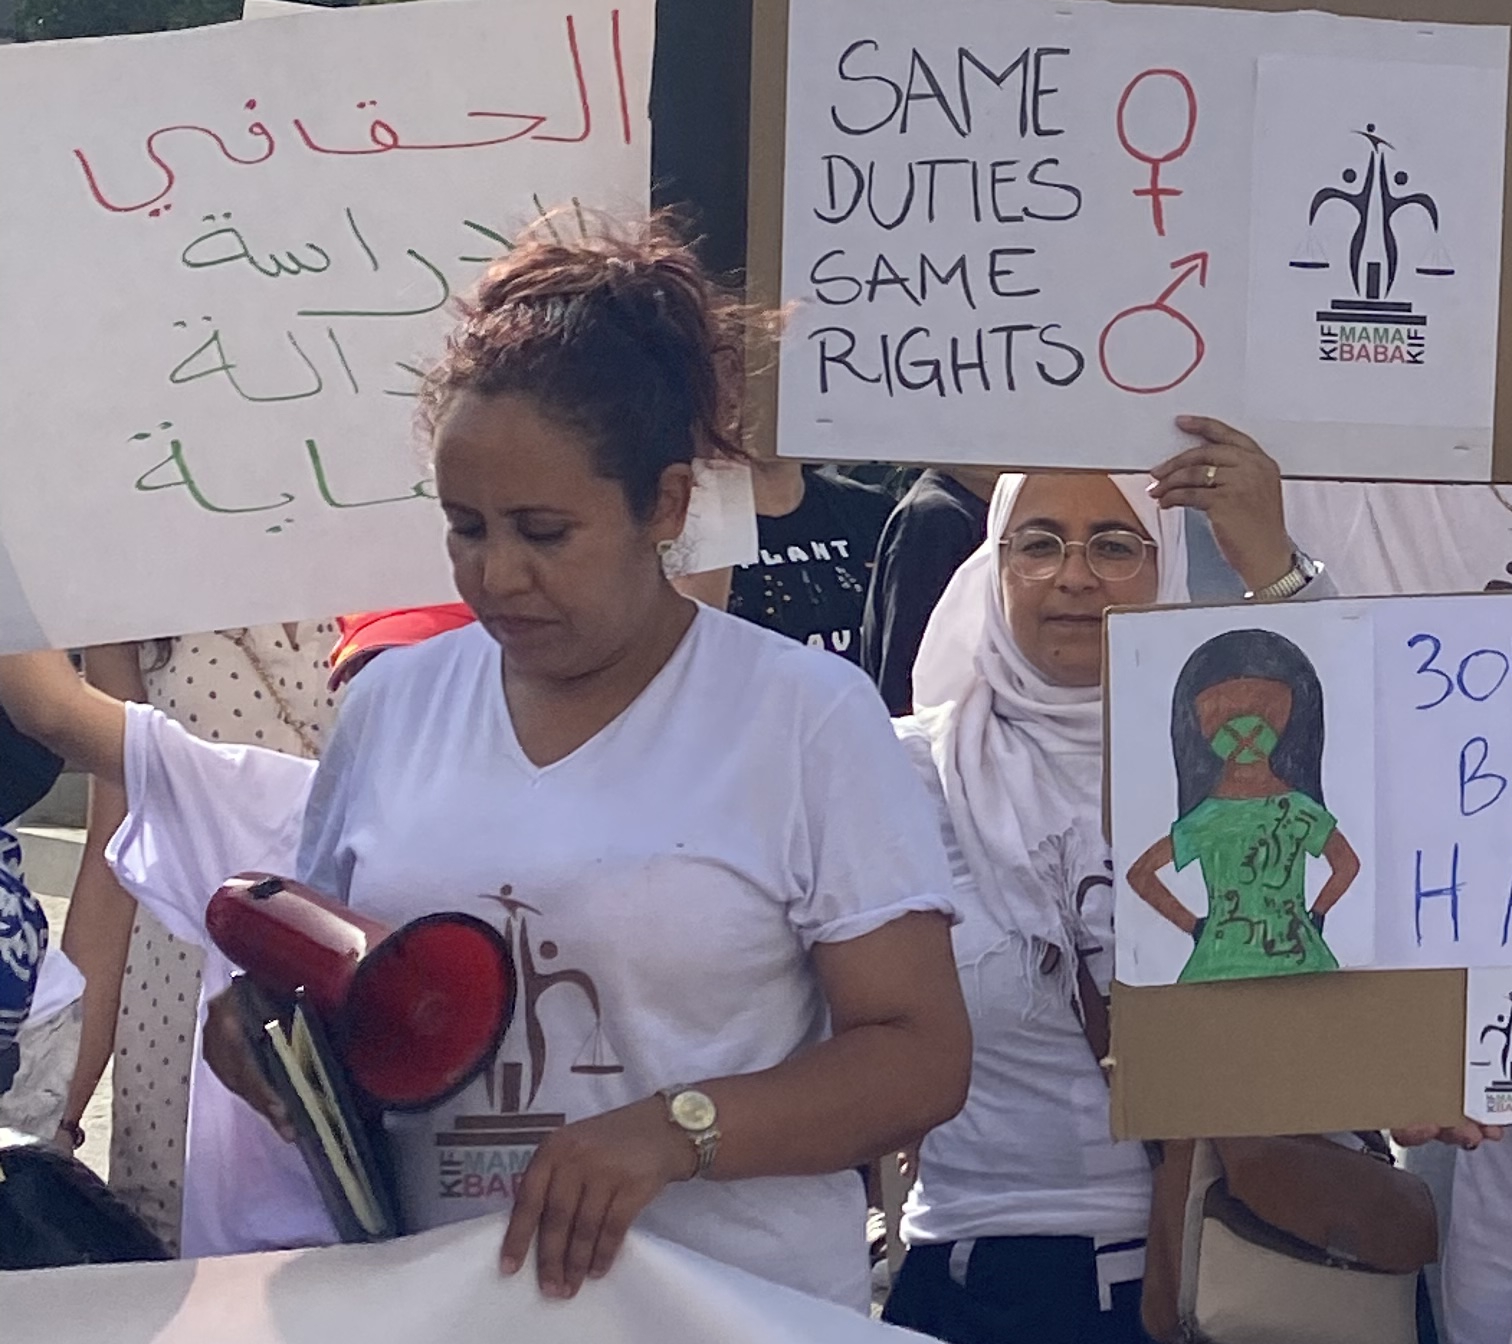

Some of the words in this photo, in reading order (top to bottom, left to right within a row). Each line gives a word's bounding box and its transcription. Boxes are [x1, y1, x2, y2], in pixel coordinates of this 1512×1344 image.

[830, 39, 1070, 137] SAME
[814, 155, 1081, 230] DUTIES
[810, 248, 1040, 308] SAME
[1319, 324, 1338, 361] KIF
[1340, 325, 1405, 344] MAMA
[1406, 328, 1425, 364] KIF
[808, 323, 1085, 397] RIGHTS
[1340, 344, 1405, 364] BABA
[740, 539, 850, 568] LANT
[438, 1150, 464, 1198] KIF
[464, 1150, 532, 1174] MAM
